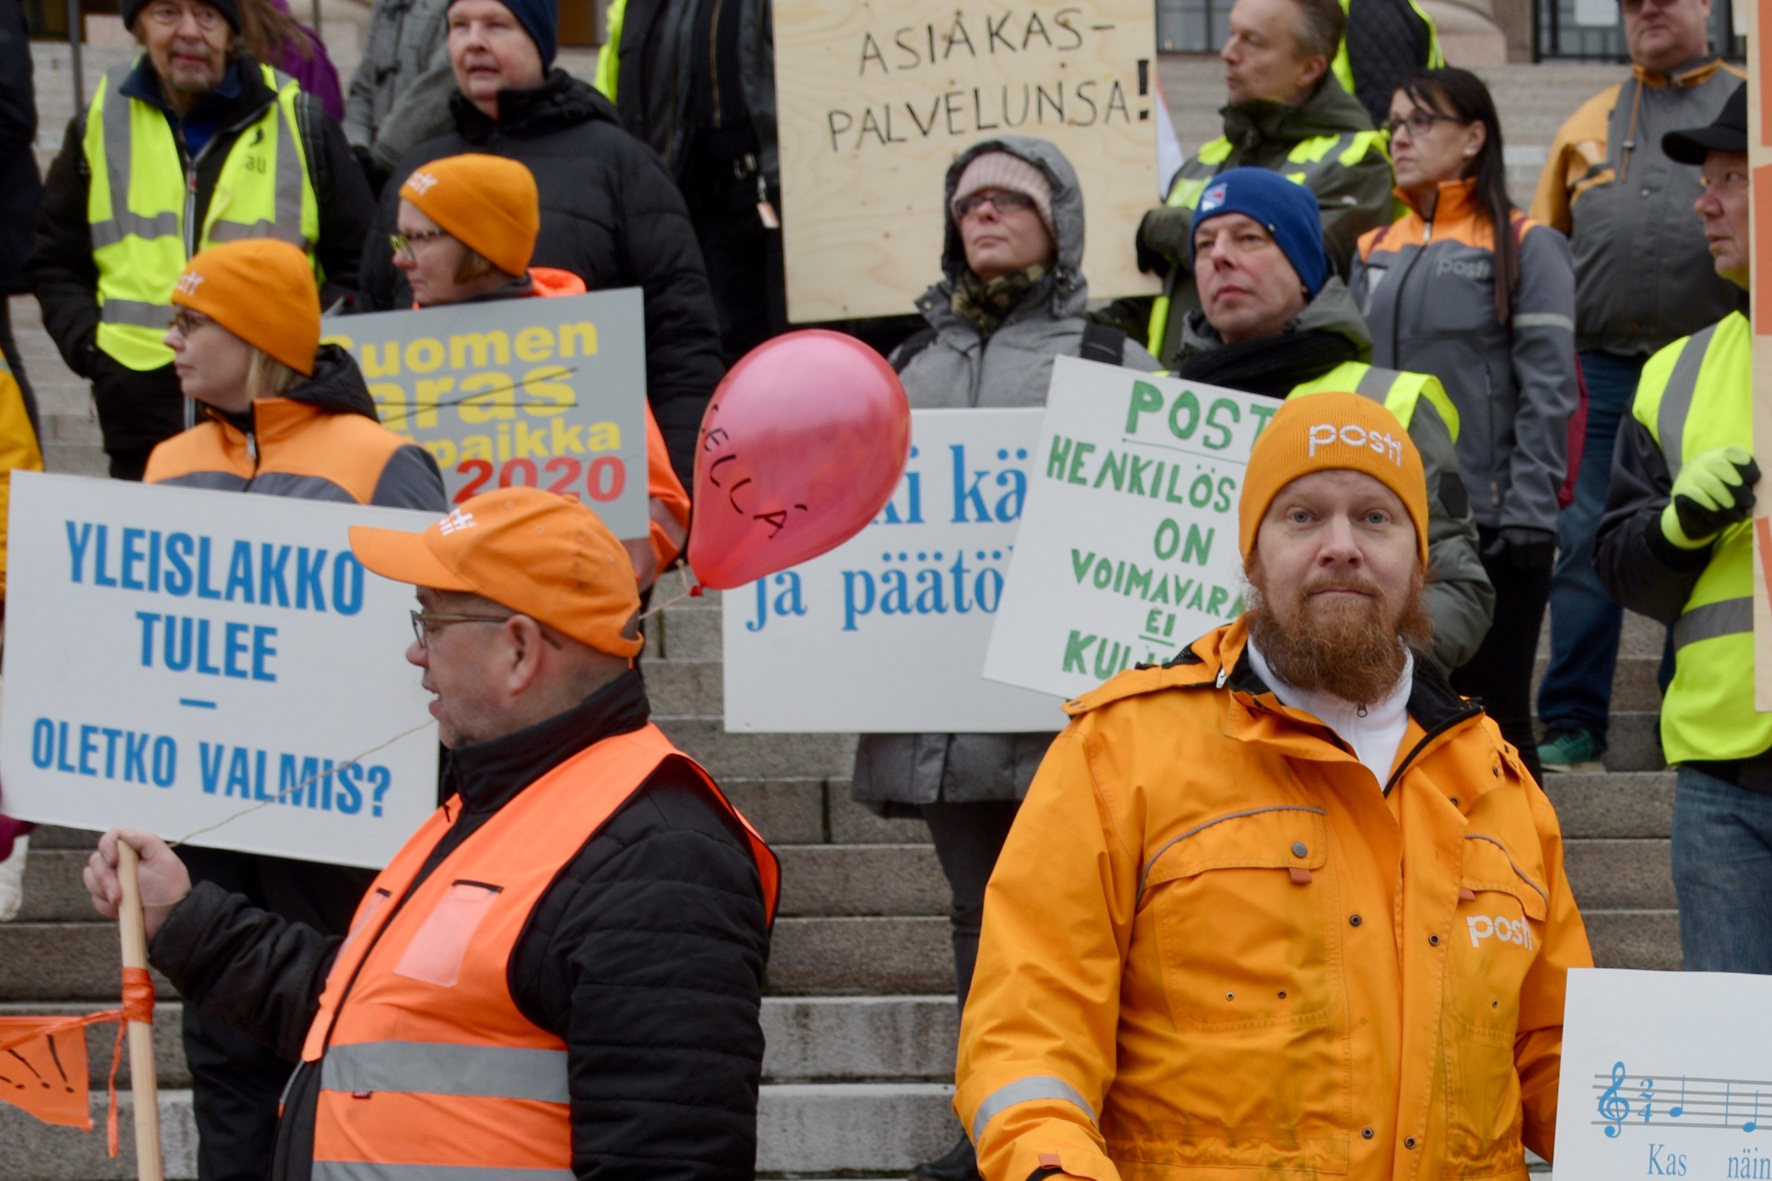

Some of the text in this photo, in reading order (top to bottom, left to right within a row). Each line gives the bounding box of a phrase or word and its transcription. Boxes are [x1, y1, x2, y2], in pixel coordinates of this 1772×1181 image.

[859, 8, 1116, 77] ASIAKAS-
[828, 59, 1150, 152] PALVELUNSA!
[1308, 423, 1404, 467] posti
[452, 455, 627, 504] 2020
[65, 519, 366, 617] YLEISLAKKO
[1153, 517, 1215, 567] ON
[745, 569, 808, 632] ja
[1144, 609, 1176, 638] EI
[135, 610, 279, 683] TULEE
[31, 716, 392, 819] OLETKO VALMIS?
[1466, 914, 1534, 952] posti
[1647, 1143, 1688, 1177] Kas
[1727, 1147, 1772, 1180] näin
